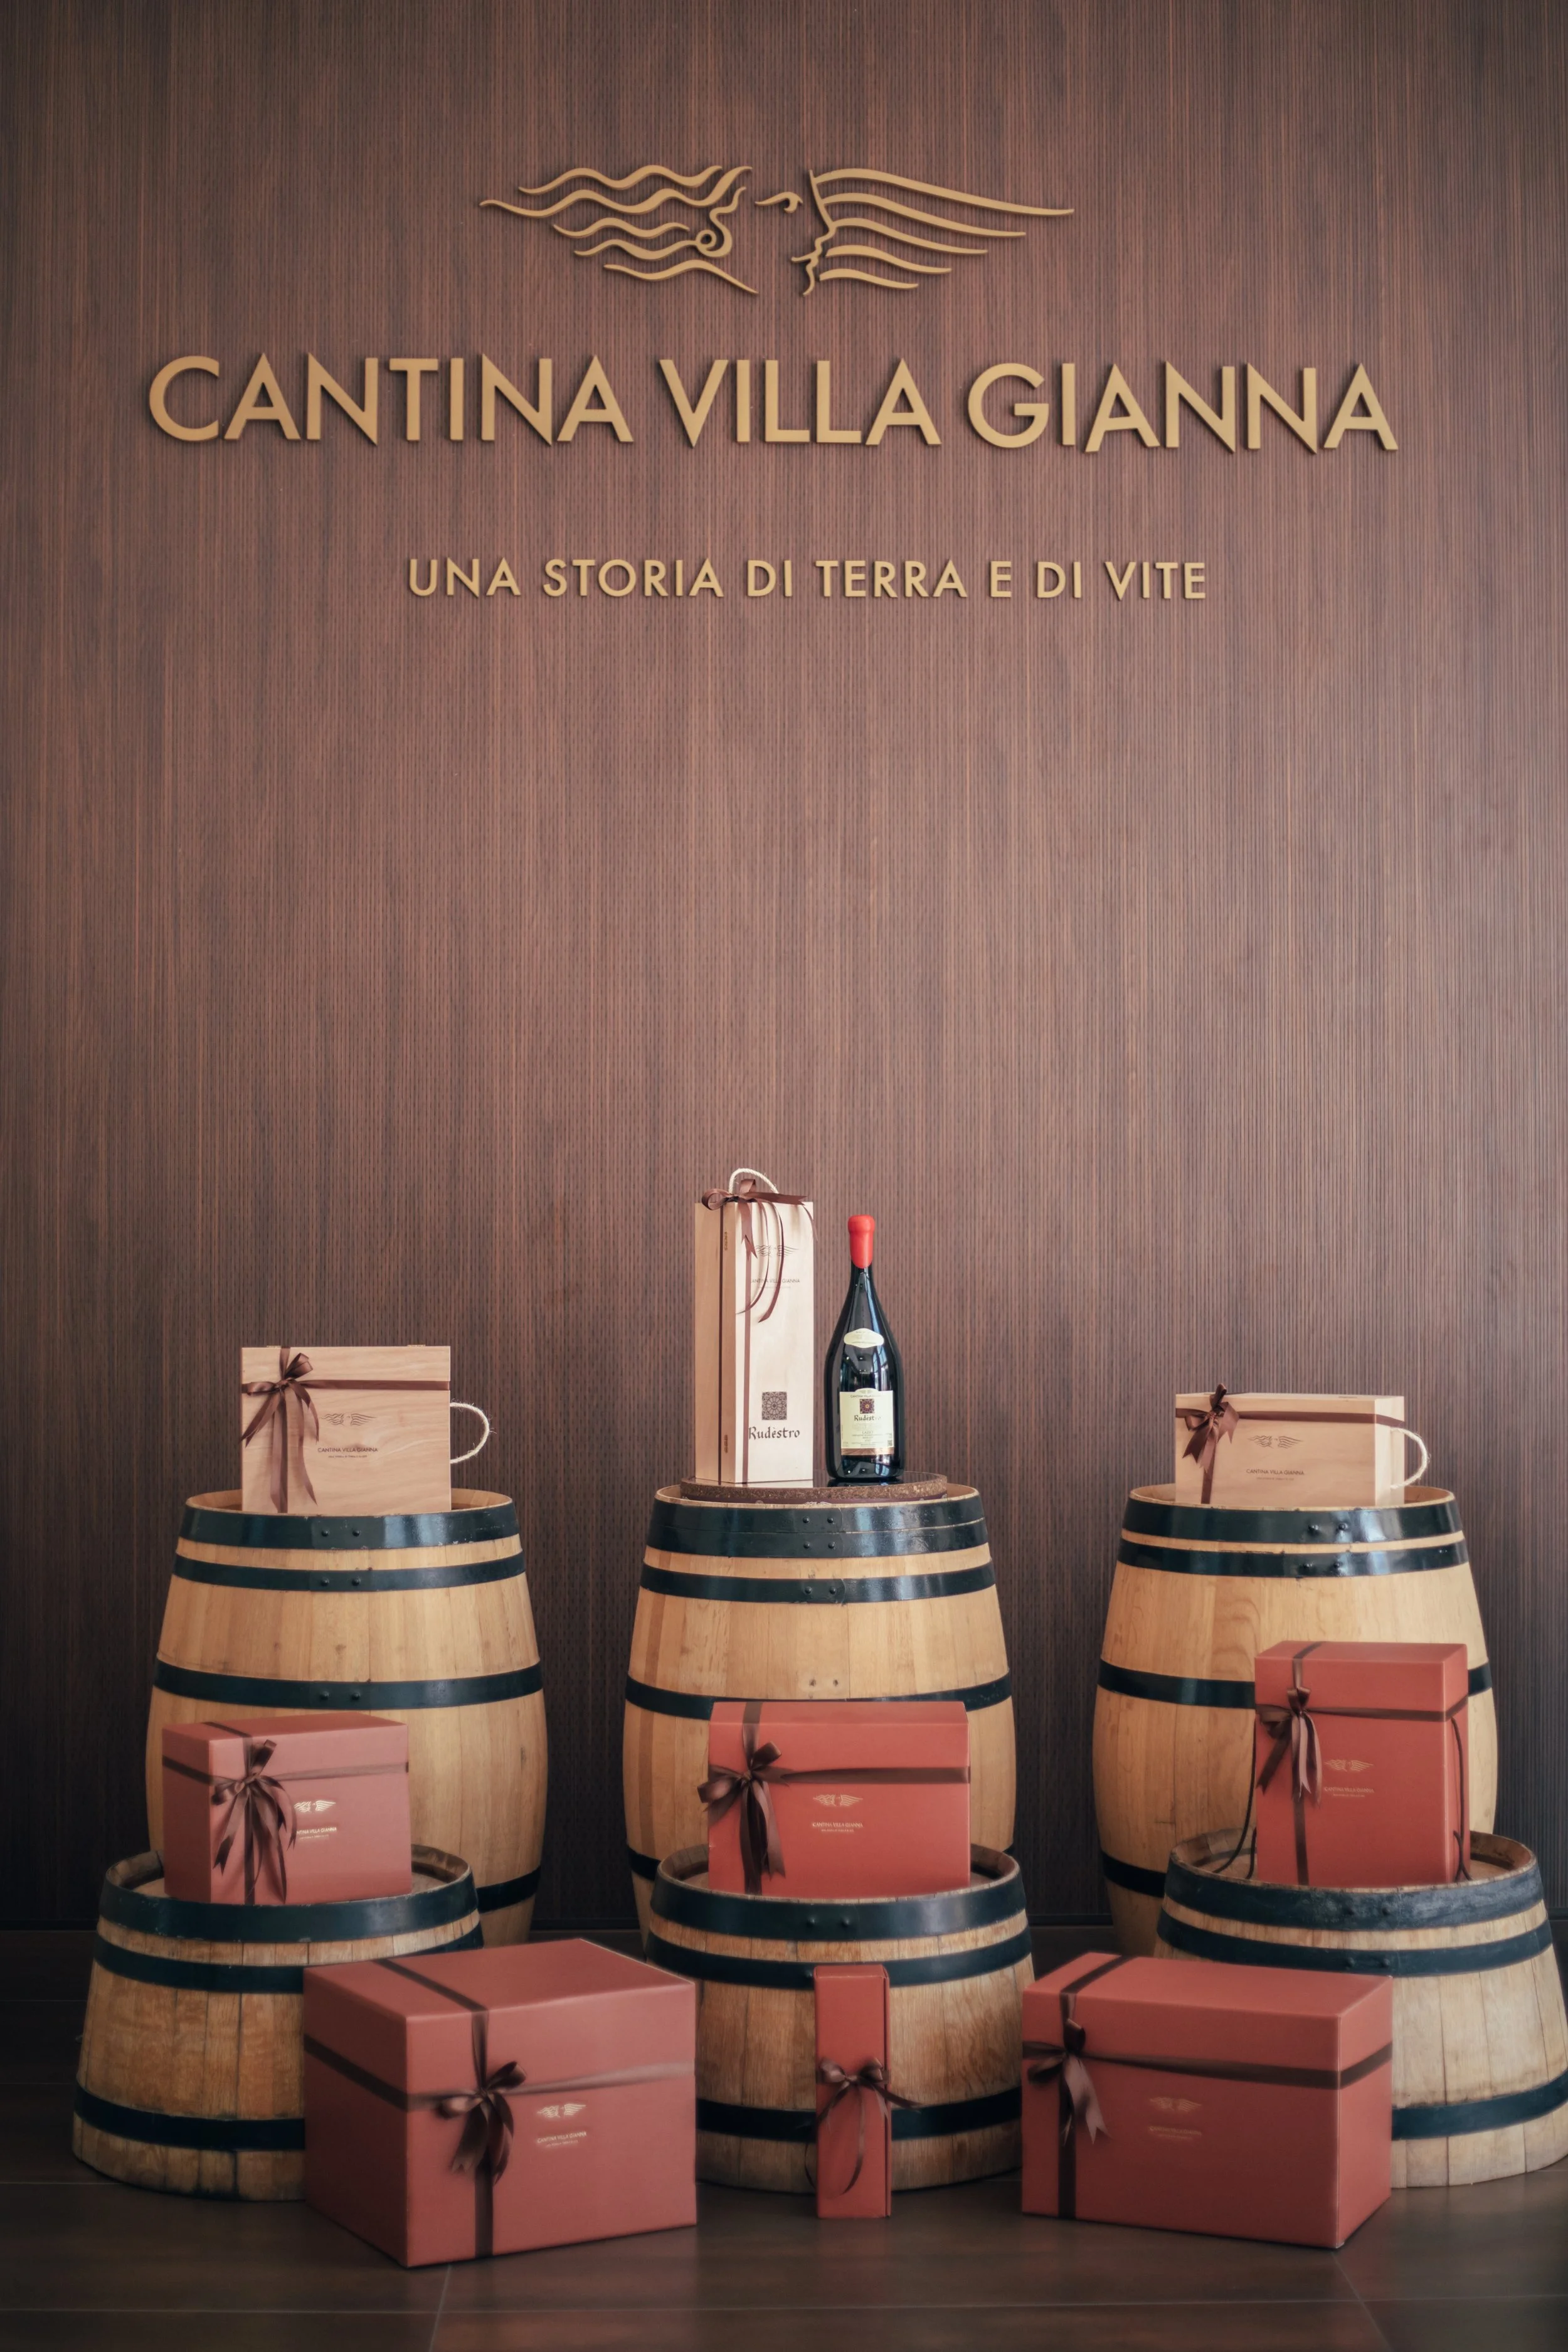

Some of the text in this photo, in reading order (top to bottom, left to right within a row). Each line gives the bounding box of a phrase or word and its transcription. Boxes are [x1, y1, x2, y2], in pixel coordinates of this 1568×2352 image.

[149, 353, 1399, 454] CANTINA VILLA GIANNA
[409, 558, 1205, 600] UNA STORIA DI TERRA E DI VITE
[748, 1426, 800, 1440] Rudèstro
